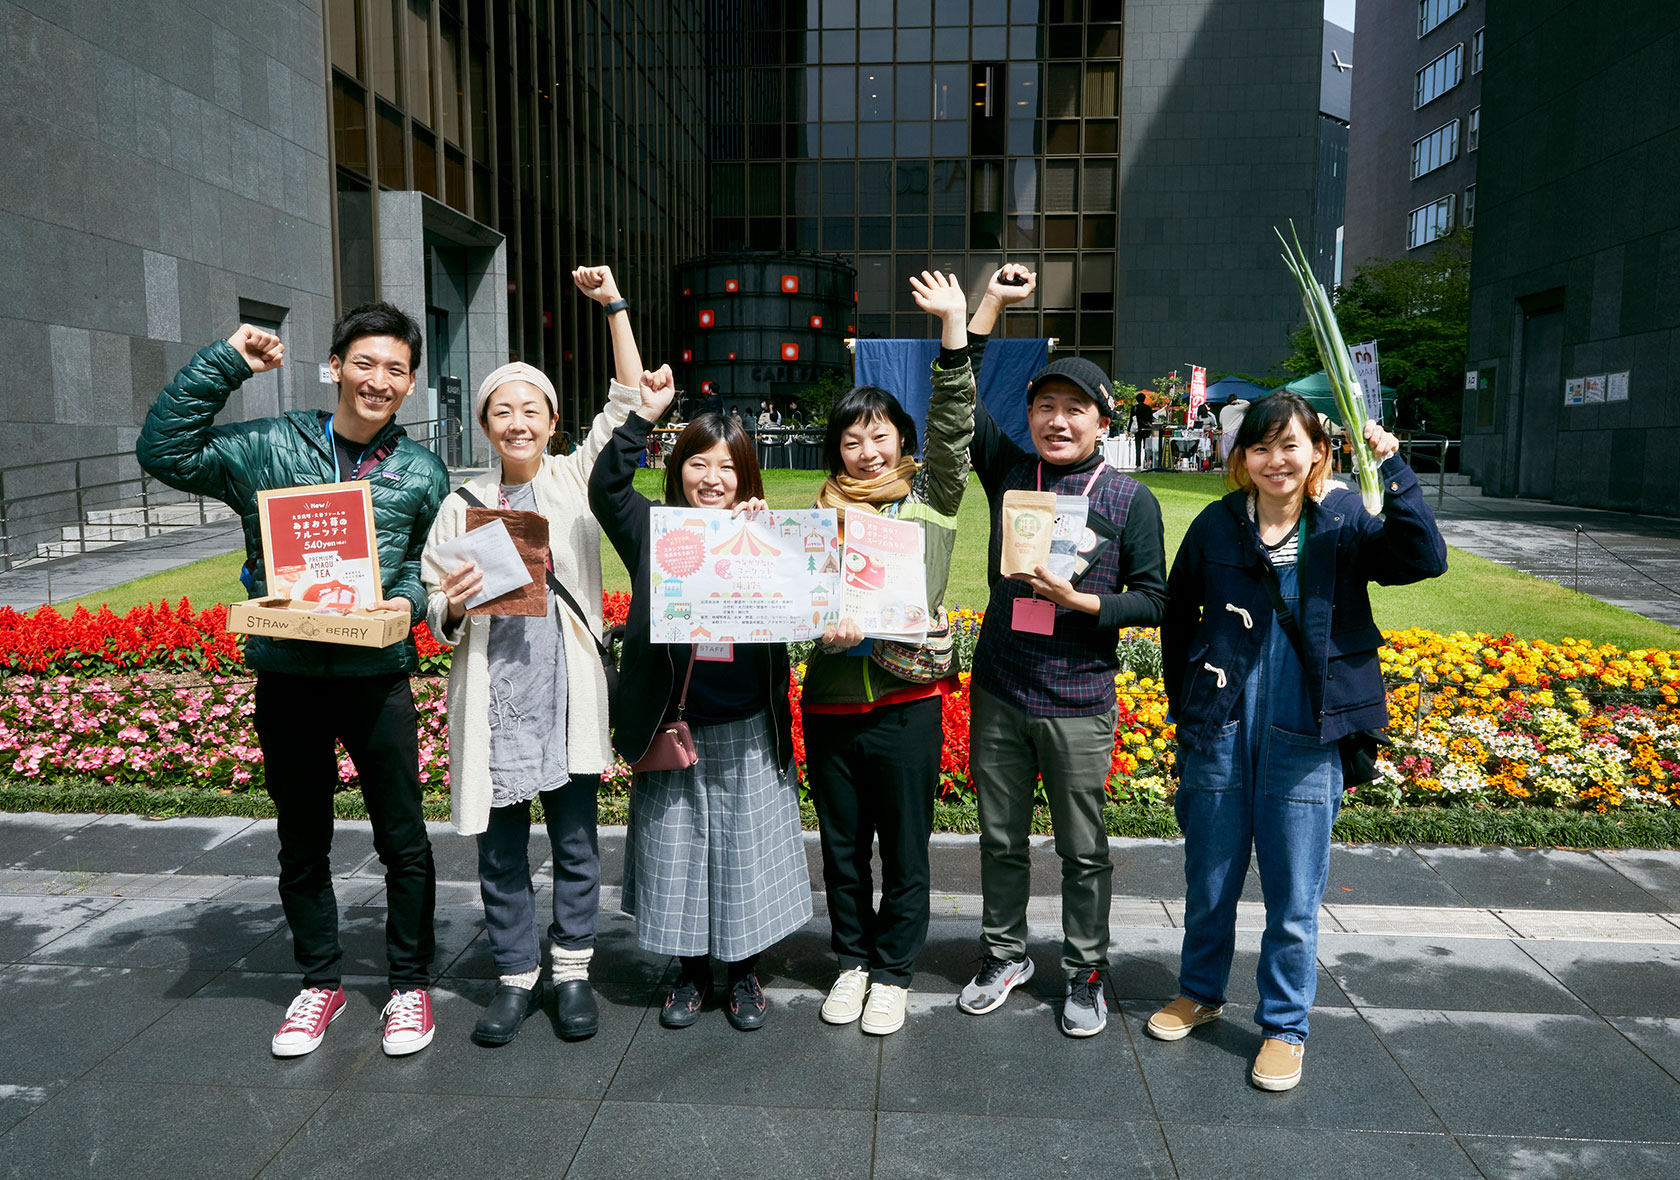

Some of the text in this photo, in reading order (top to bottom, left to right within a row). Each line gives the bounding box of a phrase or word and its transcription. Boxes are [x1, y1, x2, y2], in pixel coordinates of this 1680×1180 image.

[293, 517, 347, 530] あまおう苺の
[294, 528, 347, 540] フルーツティ
[310, 561, 334, 569] AMAOU
[315, 569, 331, 578] TEA
[246, 615, 369, 641] STRAW BERRY
[700, 645, 725, 653] STAFF
